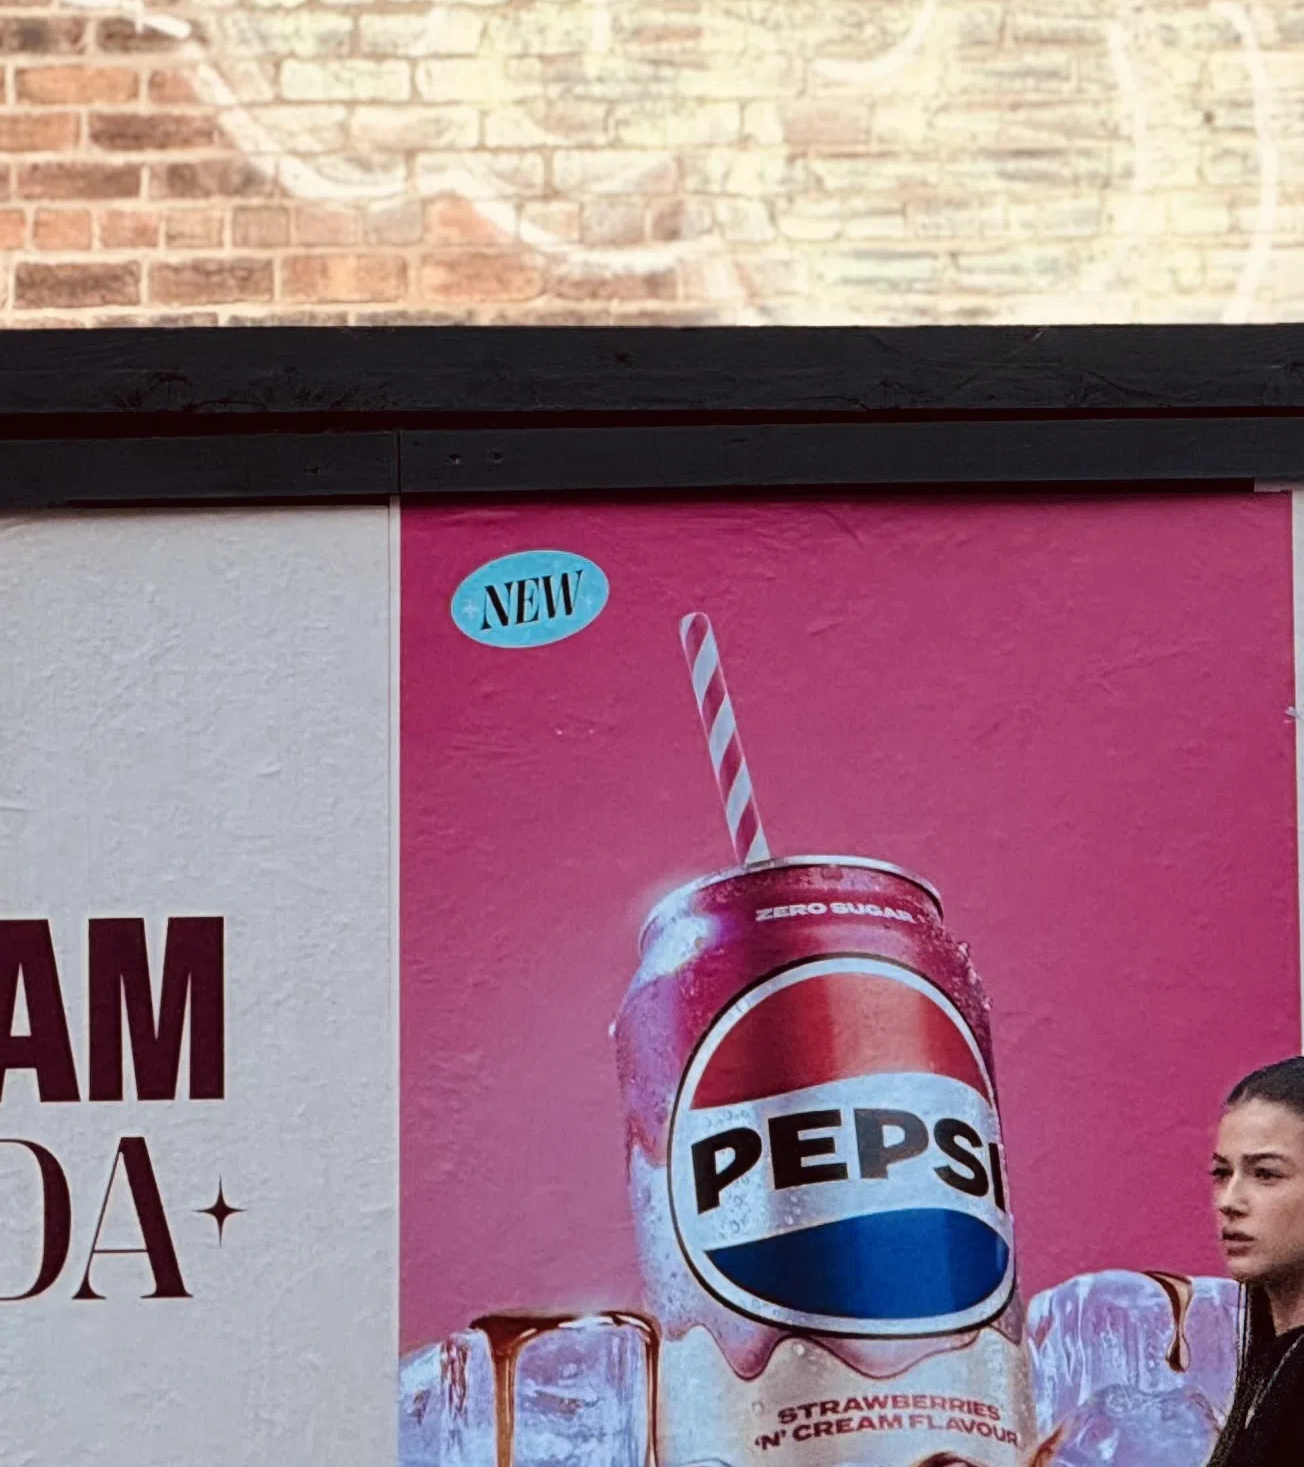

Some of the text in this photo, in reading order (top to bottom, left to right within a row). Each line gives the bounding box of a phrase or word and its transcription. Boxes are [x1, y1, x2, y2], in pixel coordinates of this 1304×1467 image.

[480, 570, 584, 631] NEW
[756, 902, 916, 923] ZERO SUGAR
[691, 1108, 1006, 1214] PEPSI
[777, 1394, 1001, 1425] STRAWBERRIES
[791, 1413, 904, 1442] CREAM
[908, 1414, 1018, 1445] FLAVOUR
